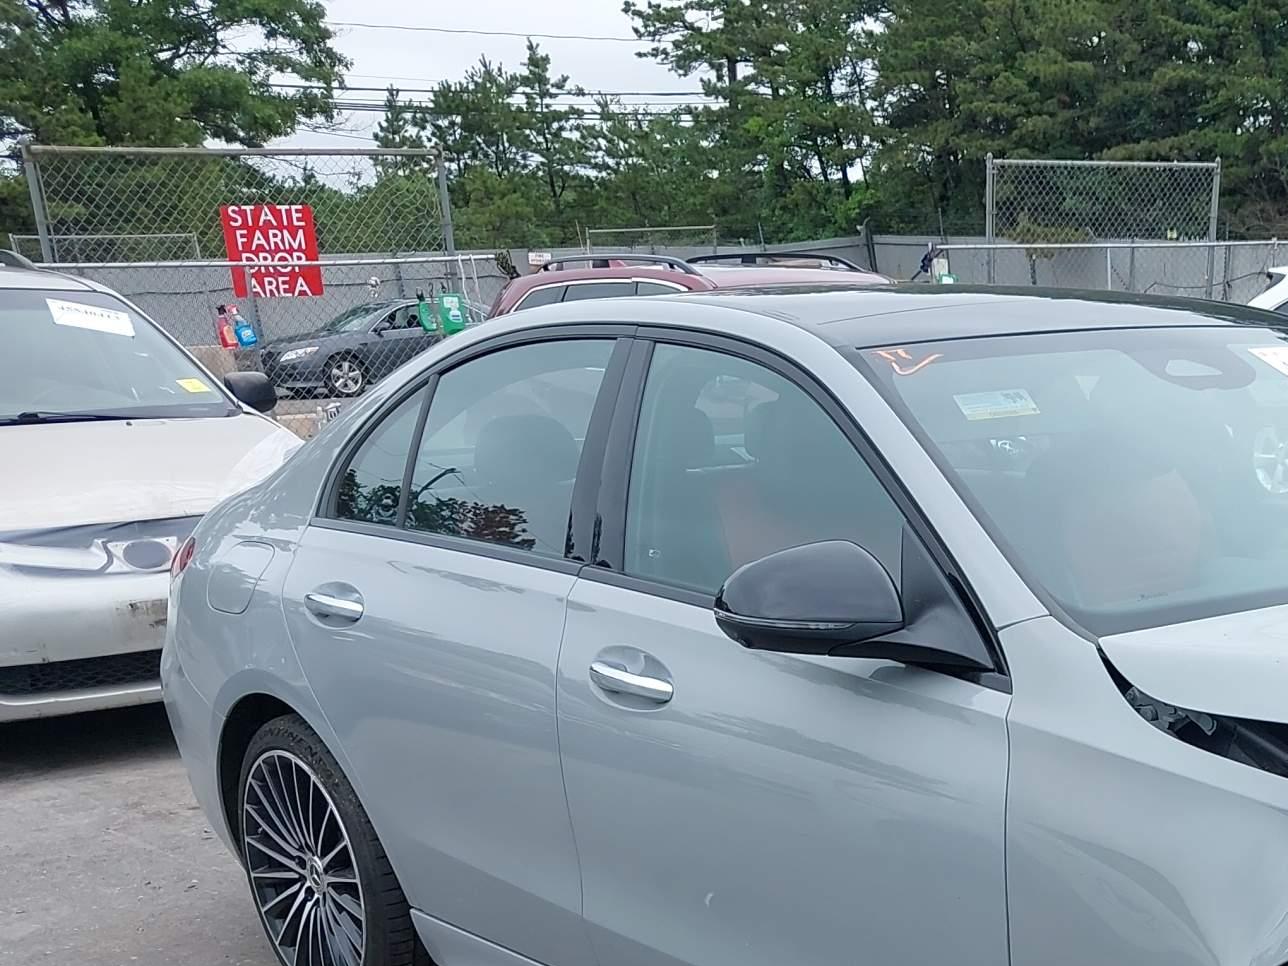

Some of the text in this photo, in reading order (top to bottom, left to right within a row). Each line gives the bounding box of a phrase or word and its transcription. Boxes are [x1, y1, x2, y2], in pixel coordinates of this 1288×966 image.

[228, 205, 306, 227] STATE
[236, 229, 306, 251] FARM
[242, 252, 306, 273] DROP
[252, 276, 313, 298] AREA
